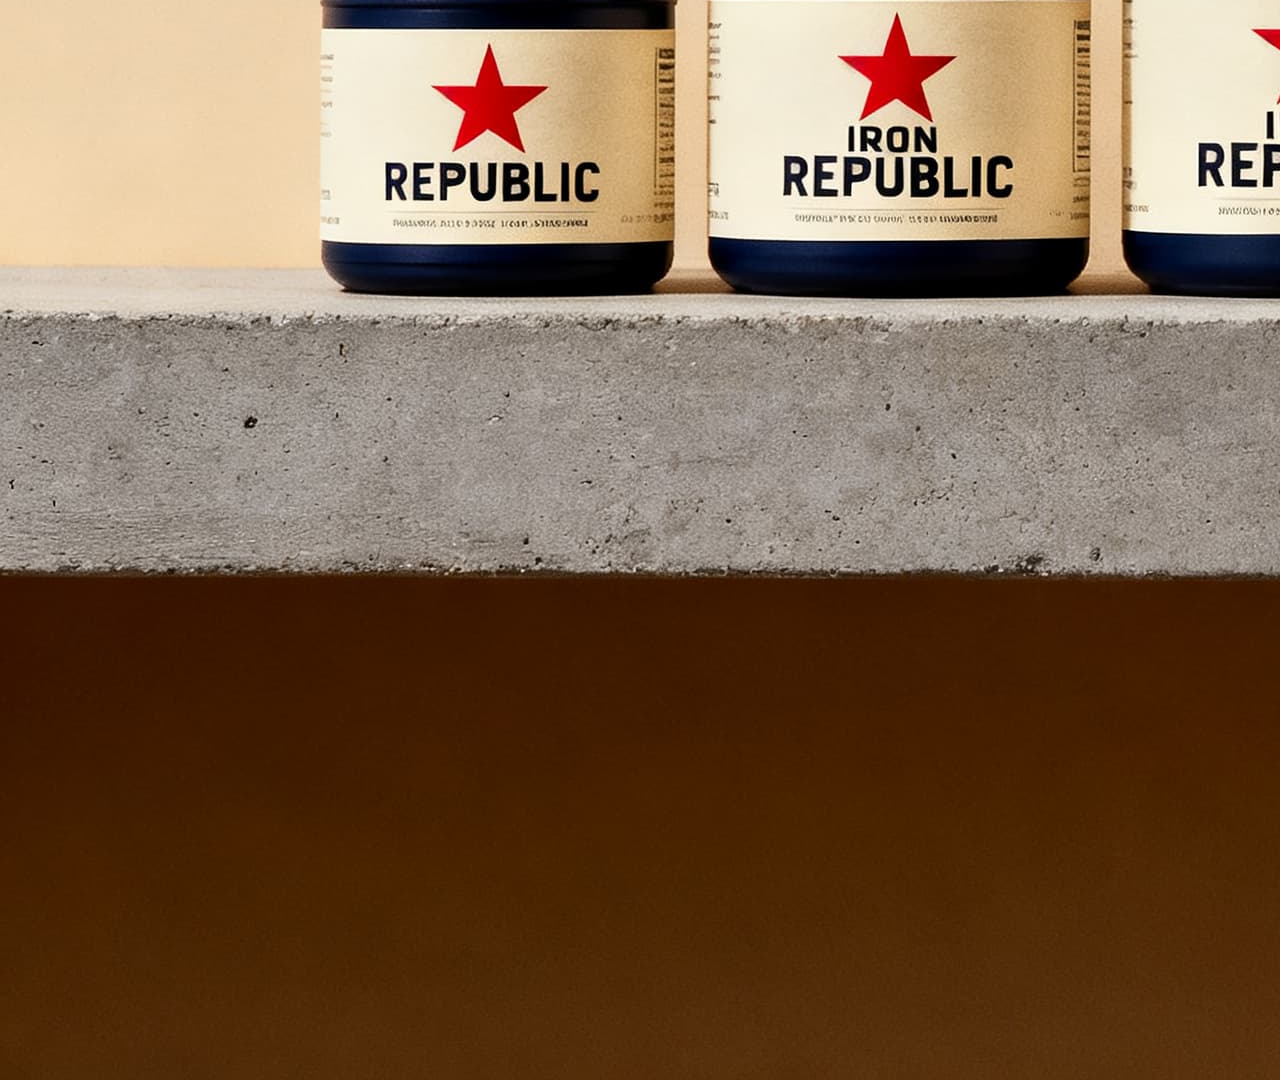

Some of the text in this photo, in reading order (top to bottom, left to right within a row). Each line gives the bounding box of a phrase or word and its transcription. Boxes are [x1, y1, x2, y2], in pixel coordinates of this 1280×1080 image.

[848, 125, 938, 154] IRON
[385, 161, 601, 203] REPUBLIC
[783, 155, 1014, 199] REPUBLIC
